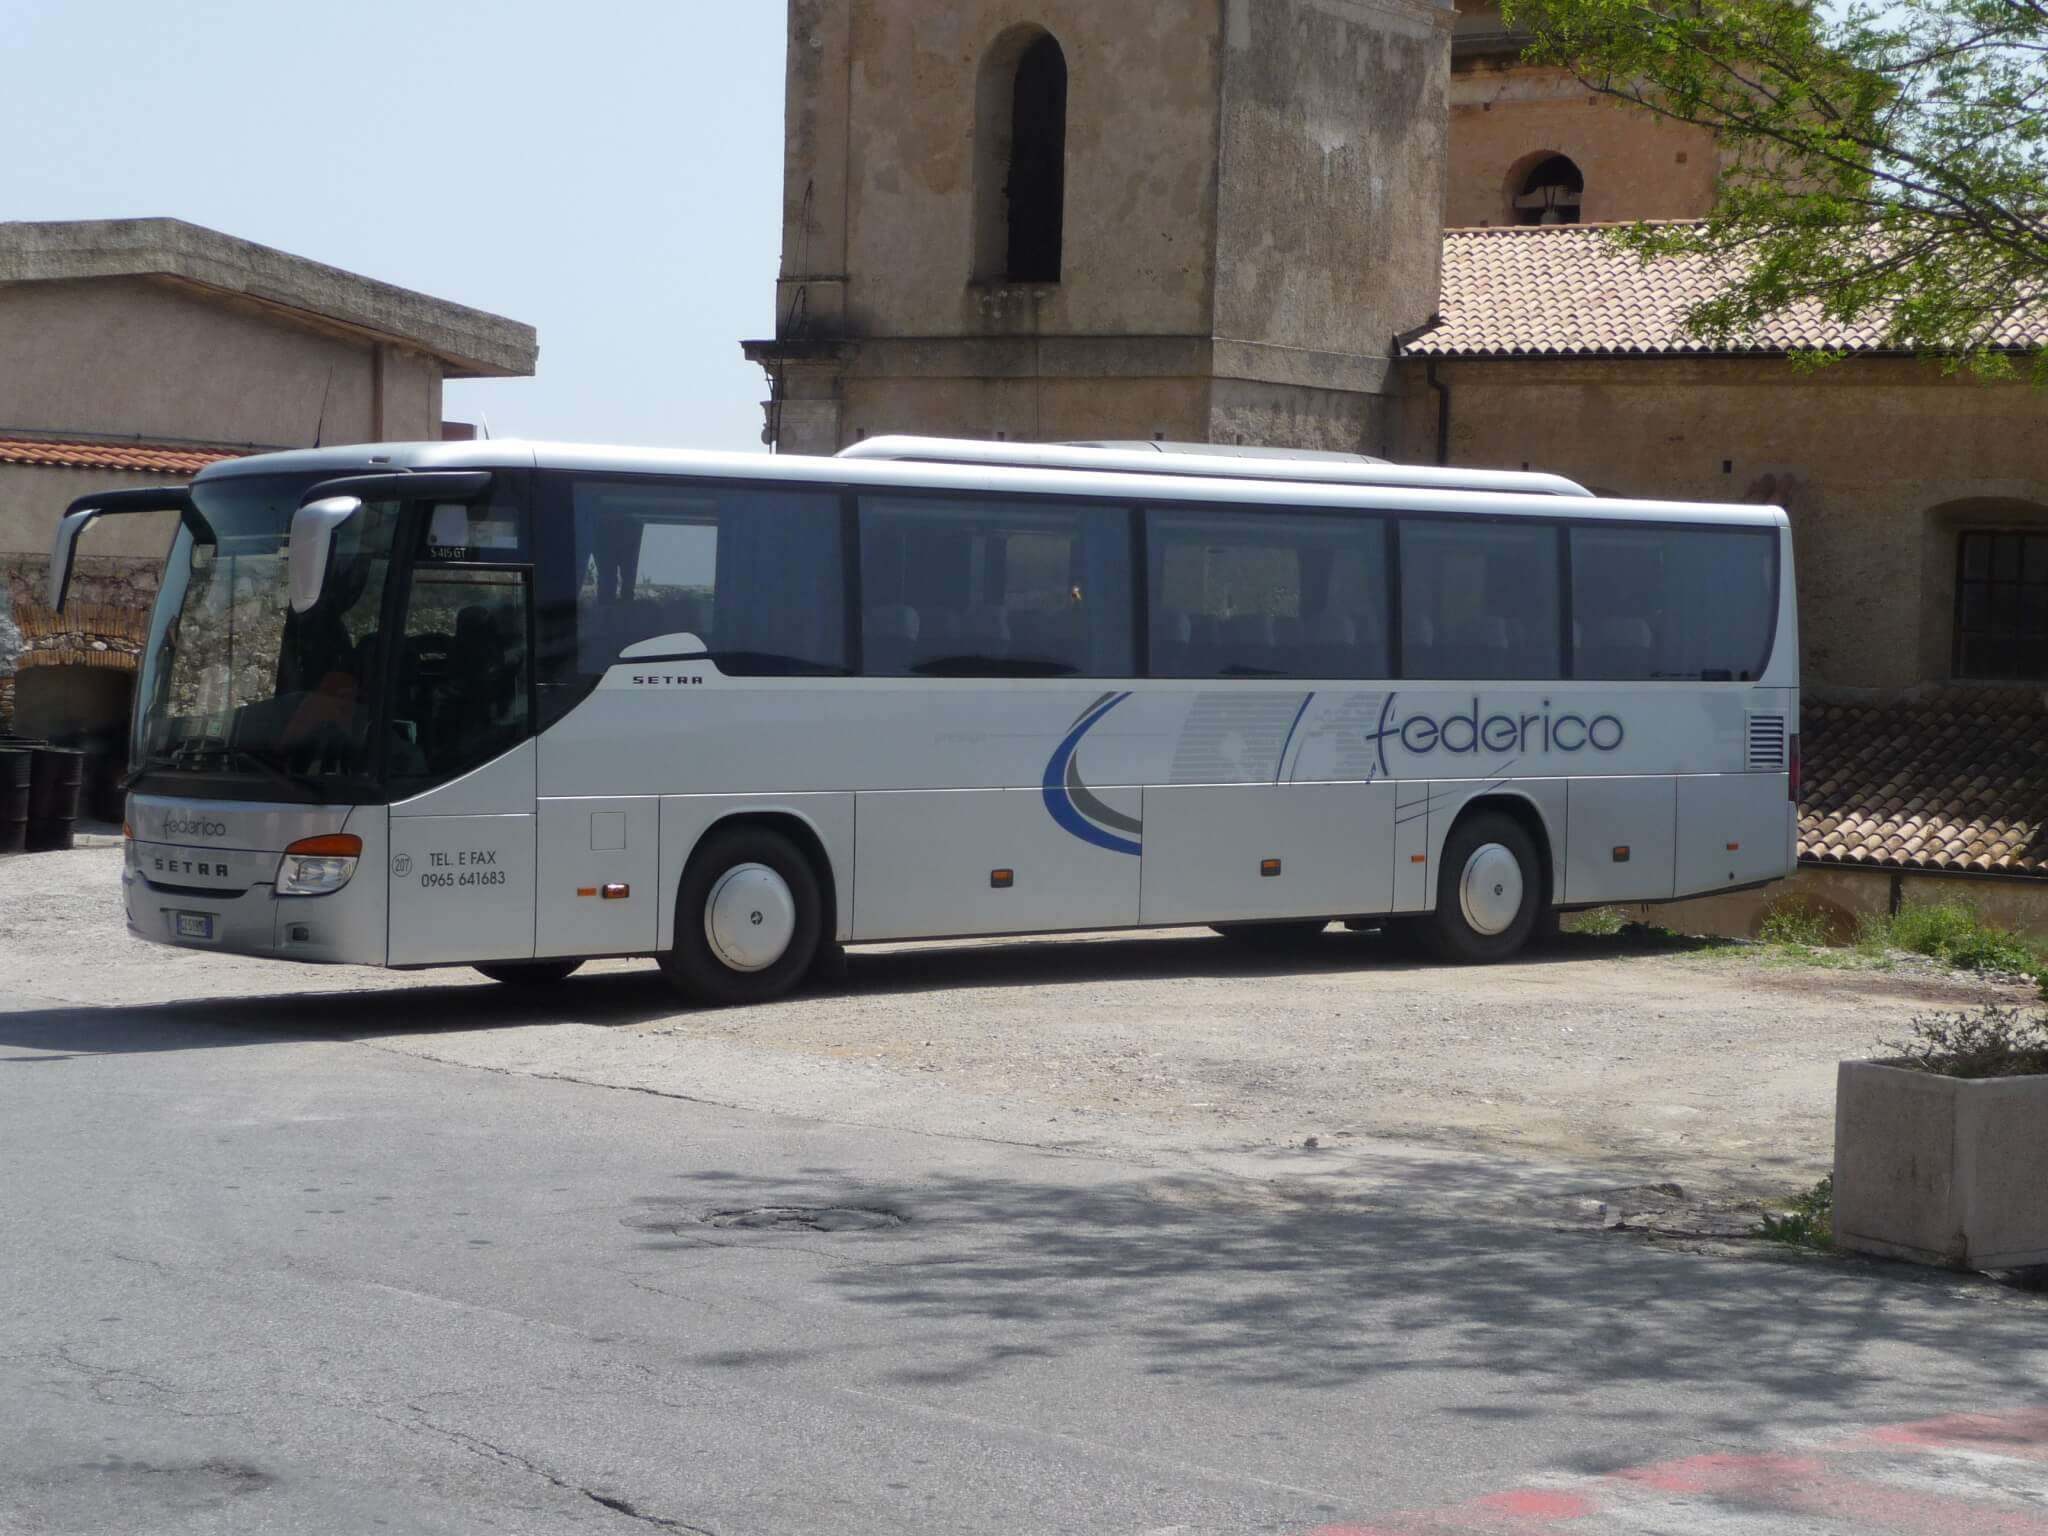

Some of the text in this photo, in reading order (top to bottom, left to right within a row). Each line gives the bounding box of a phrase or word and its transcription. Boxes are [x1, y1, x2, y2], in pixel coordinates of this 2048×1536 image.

[633, 676, 703, 685] SETRA
[1365, 691, 1624, 776] federico
[162, 810, 226, 840] federico
[154, 858, 228, 877] SETRA
[430, 850, 496, 867] TEL. E FAX
[421, 871, 506, 888] 0965 641683
